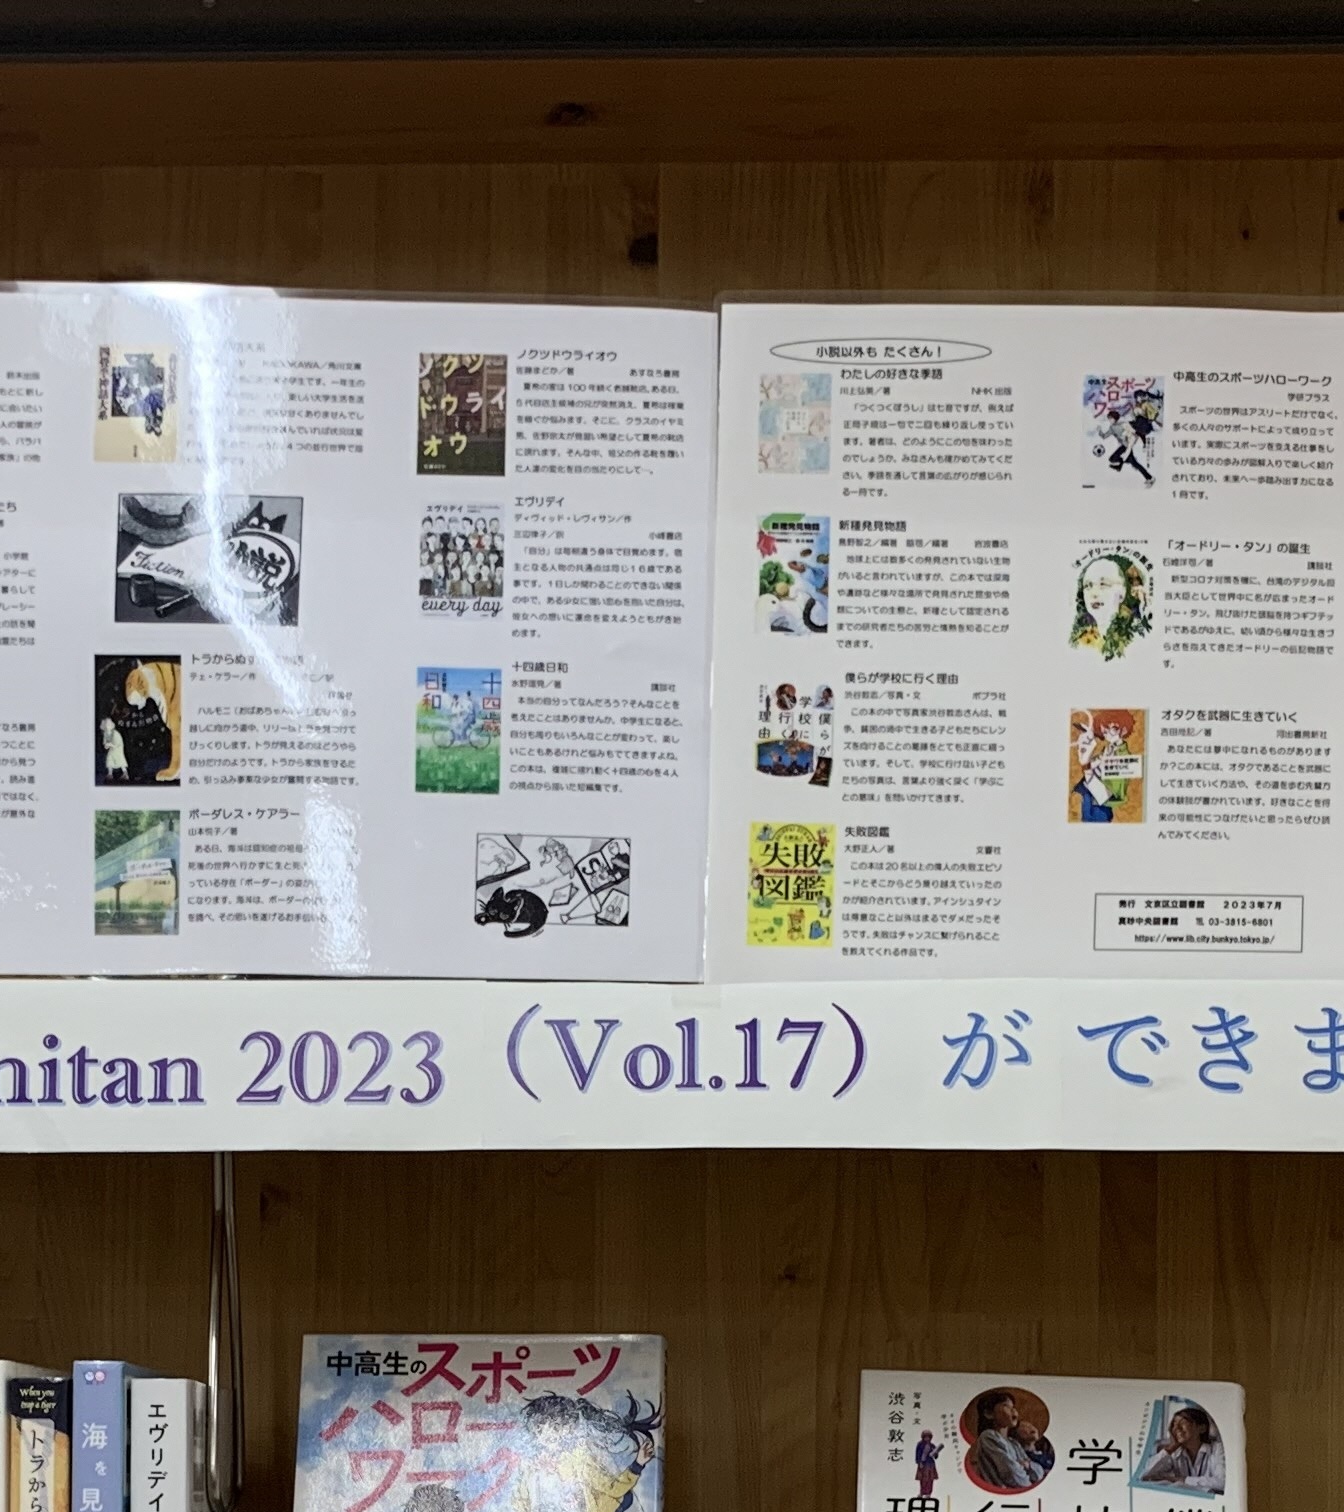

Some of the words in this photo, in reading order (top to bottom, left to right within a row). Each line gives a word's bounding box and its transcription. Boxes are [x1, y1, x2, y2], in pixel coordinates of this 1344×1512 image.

[516, 350, 618, 362] ノクツドウライオウ
[816, 346, 877, 358] 小説以外も
[840, 368, 943, 380] わたしの好きな季語
[1173, 371, 1332, 386] 中高生のスポーツハローワーク
[839, 520, 907, 532] 新種発見物語
[130, 551, 185, 578] Fiction
[512, 661, 568, 674] 十四歳日和
[845, 672, 959, 684] 僕らが学校に行く理由
[1161, 709, 1298, 723] オタクを武器に生きていく
[844, 826, 890, 838] 失敗図鑑
[1208, 918, 1273, 926] 03-3815-6801
[236, 1028, 446, 1109] 2023
[942, 1008, 1033, 1091] が
[318, 1400, 516, 1450] ハロー
[888, 1392, 905, 1462] 渋谷敦志
[148, 1404, 168, 1512] エヴリデイ
